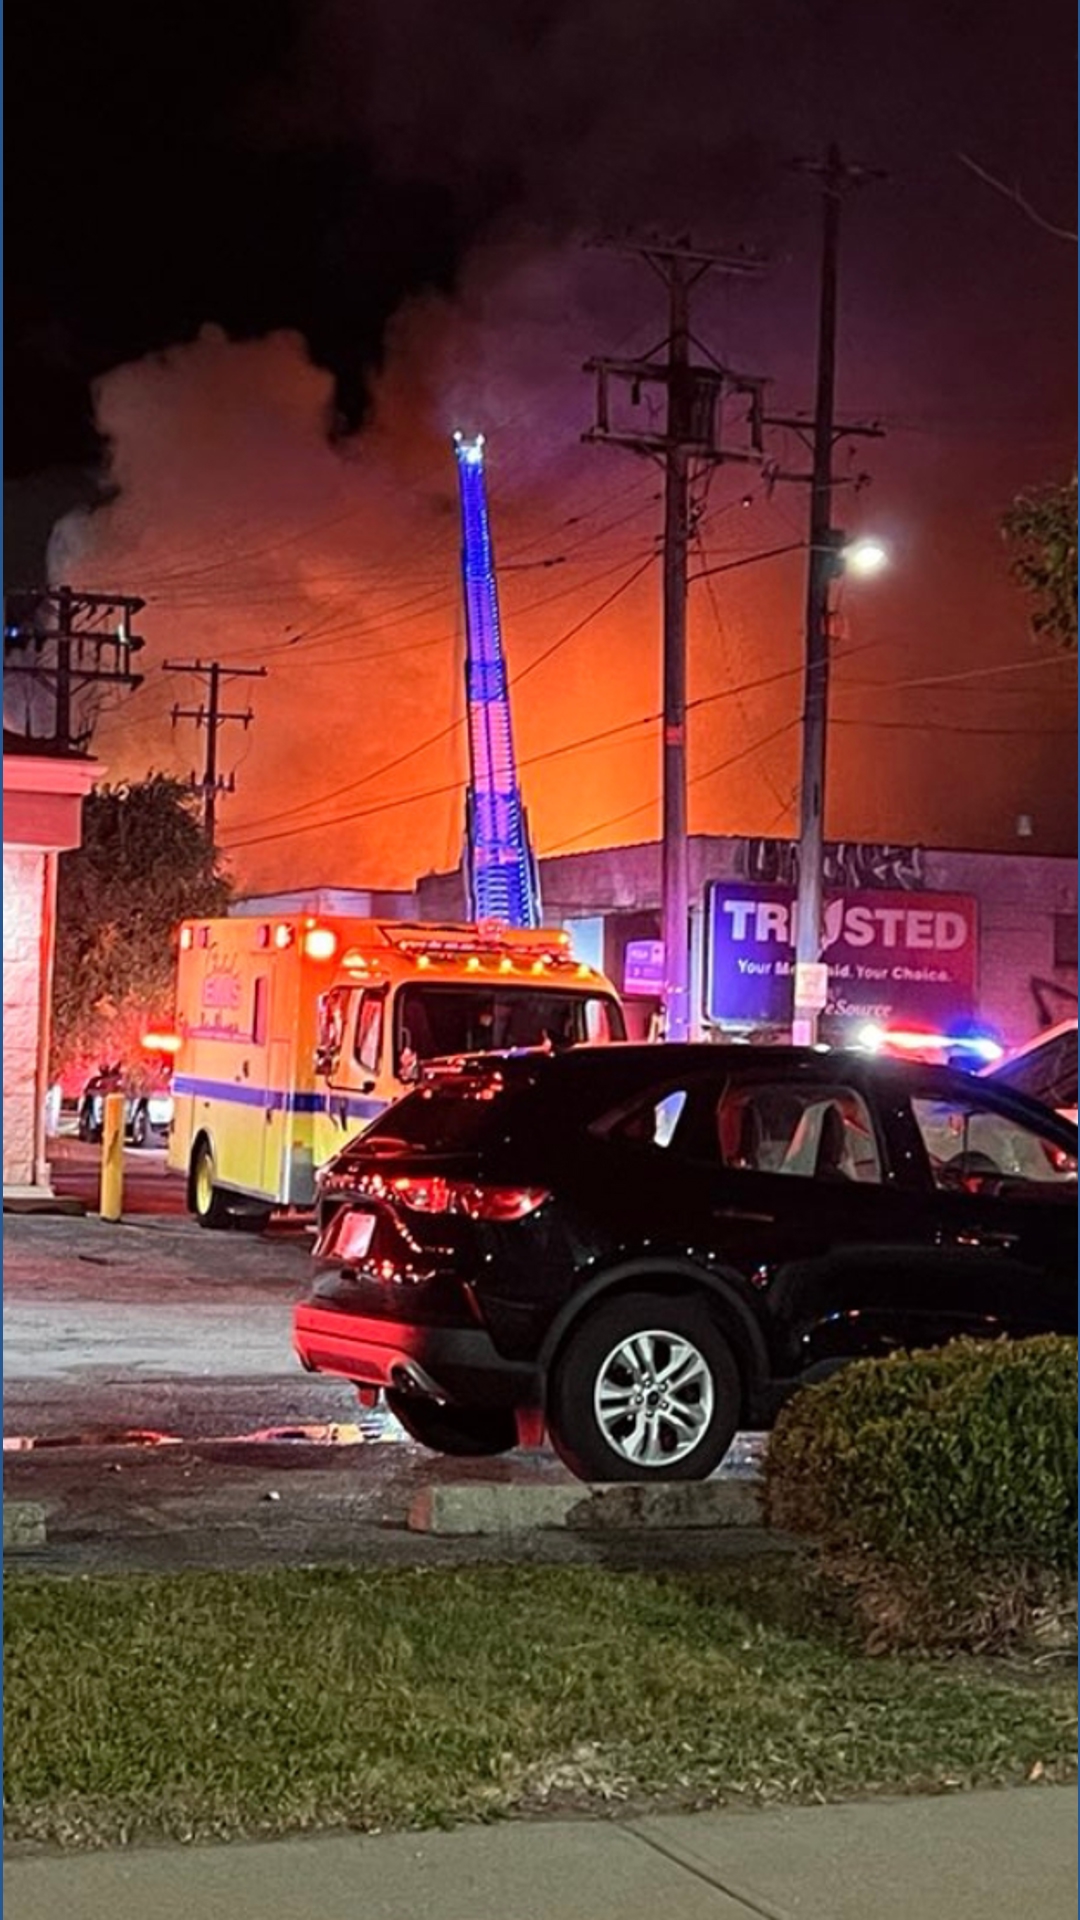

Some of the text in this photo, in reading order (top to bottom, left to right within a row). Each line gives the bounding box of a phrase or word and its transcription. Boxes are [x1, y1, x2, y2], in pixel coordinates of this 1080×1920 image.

[737, 958, 772, 975] Your
[855, 966, 889, 981] Your
[891, 966, 952, 983] Choice.
